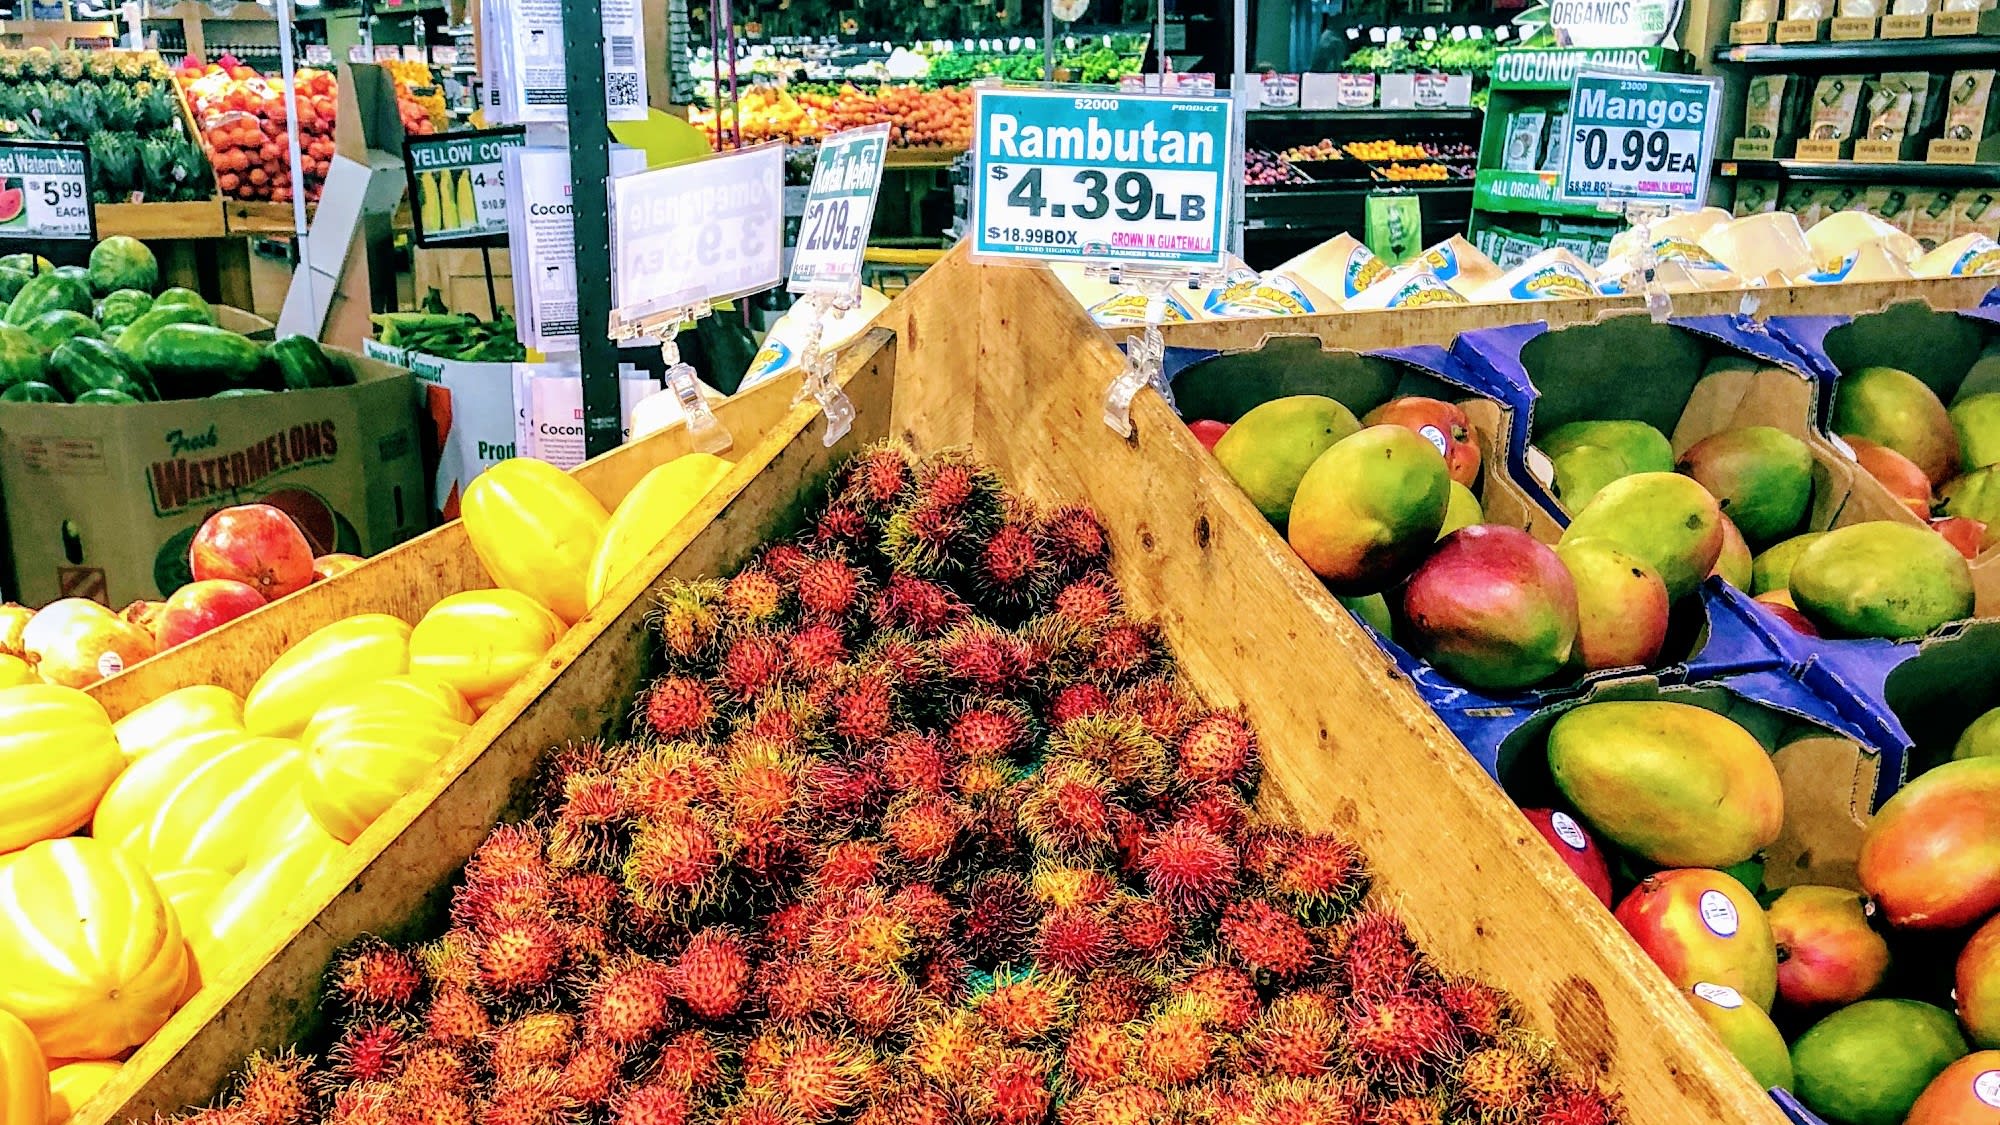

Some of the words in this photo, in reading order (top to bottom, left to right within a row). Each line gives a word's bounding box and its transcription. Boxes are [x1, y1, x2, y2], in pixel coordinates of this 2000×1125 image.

[1552, 1, 1630, 25] ORGANICS
[1074, 99, 1119, 111] 52000
[1171, 104, 1219, 113] PRODUCE
[1578, 88, 1704, 128] Mangos
[989, 113, 1214, 164] Rambutan
[15, 152, 84, 174] Watermelon
[410, 144, 473, 167] YELLOW
[1491, 179, 1507, 195] ALL
[1510, 181, 1550, 200] ORGANIC
[56, 206, 86, 217] EACH
[1014, 245, 1045, 254] BUFORD
[1046, 247, 1081, 255] HIGHWAY
[1111, 231, 1144, 247] GROWN
[1146, 233, 1156, 248] IN
[1157, 234, 1212, 251] GUATEMALA
[1110, 249, 1147, 257] FARMERS
[1148, 250, 1181, 259] MARKET
[165, 424, 218, 456] Fresh
[151, 419, 338, 509] WATERMELONS
